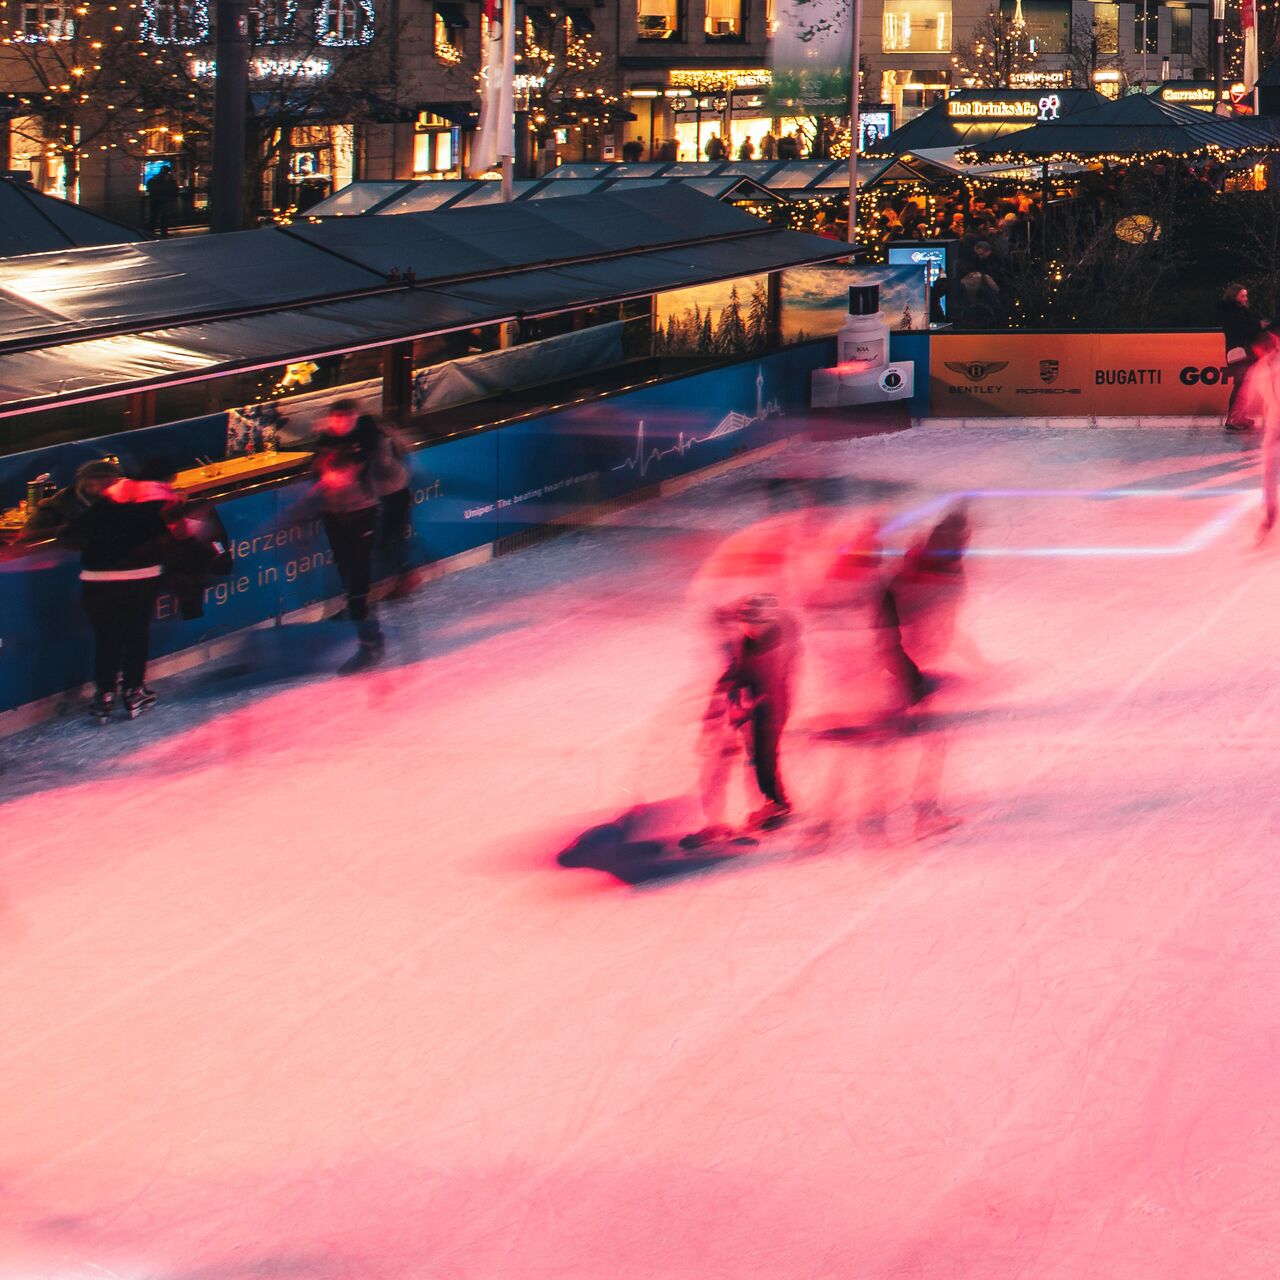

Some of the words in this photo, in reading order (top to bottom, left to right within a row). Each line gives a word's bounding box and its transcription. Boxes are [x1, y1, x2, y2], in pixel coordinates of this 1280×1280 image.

[949, 101, 972, 115] Hot
[1095, 369, 1141, 385] BUGATTI
[949, 385, 1002, 394] BENTLEY
[464, 504, 496, 520] Uniper.
[497, 499, 512, 509] The
[513, 488, 542, 504] beating
[257, 565, 278, 587] in
